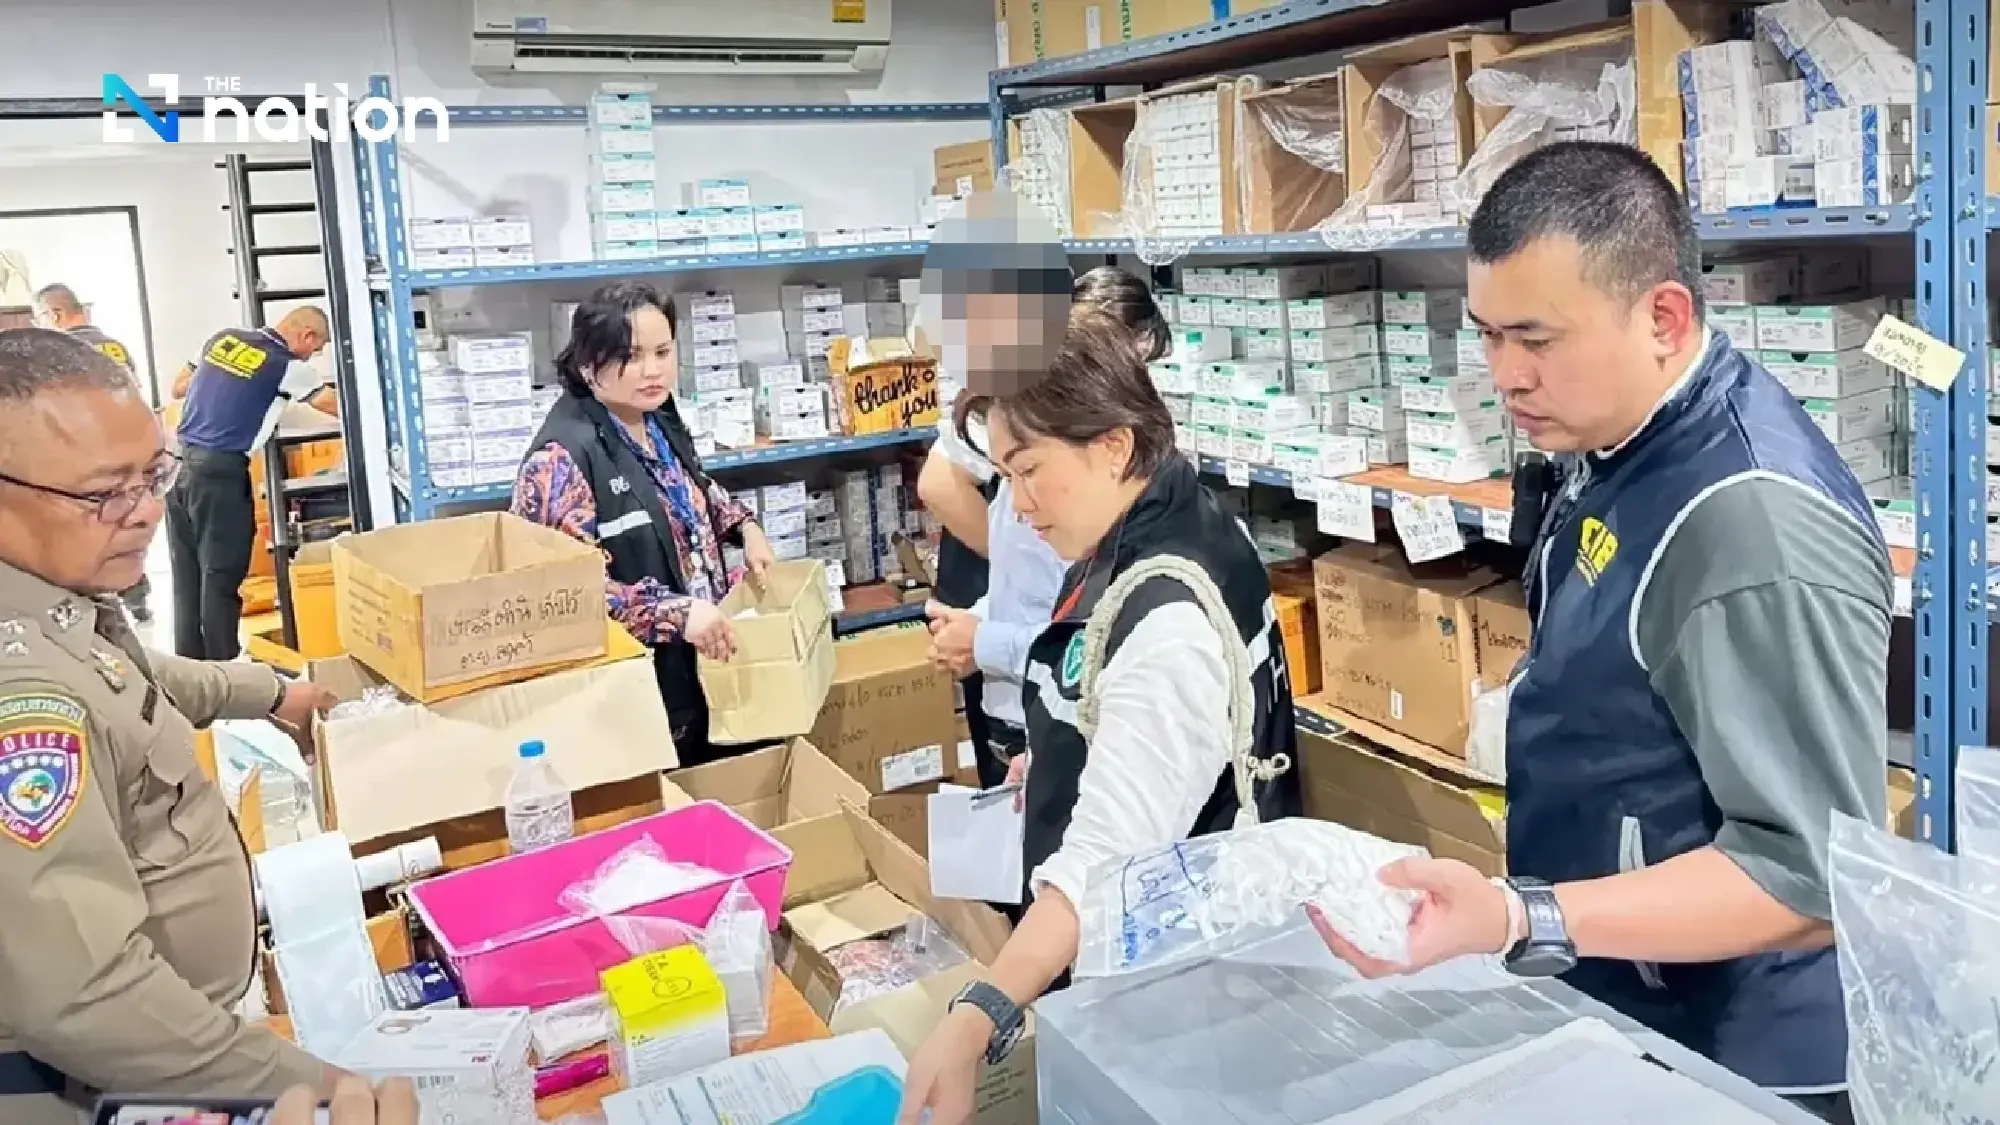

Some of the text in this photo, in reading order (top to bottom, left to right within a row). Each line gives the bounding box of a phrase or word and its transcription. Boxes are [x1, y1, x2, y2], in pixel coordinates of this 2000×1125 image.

[211, 335, 267, 371] CIB
[855, 362, 918, 414] thank
[902, 388, 938, 428] you
[1582, 516, 1618, 574] CIB
[2, 732, 72, 753] OLICE
